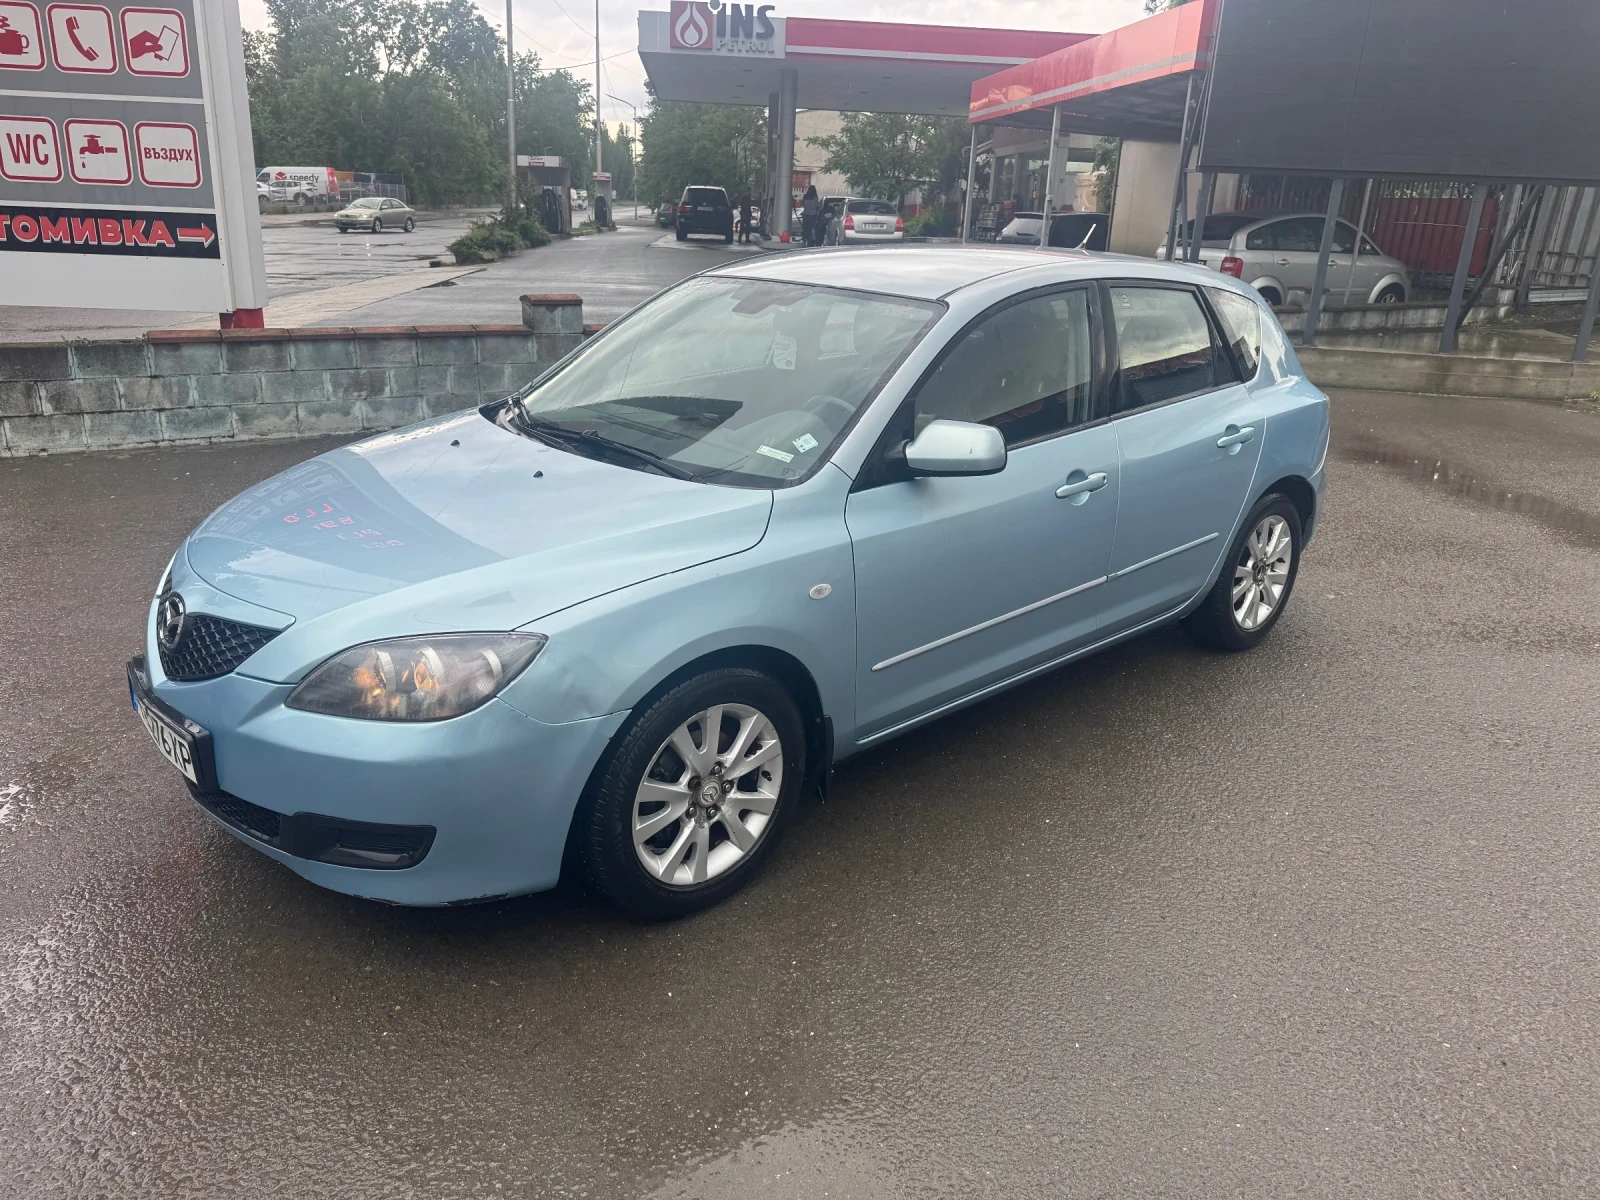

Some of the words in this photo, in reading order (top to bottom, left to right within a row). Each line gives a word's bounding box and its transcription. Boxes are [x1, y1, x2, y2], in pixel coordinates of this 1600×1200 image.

[715, 39, 775, 54] PETROL
[6, 132, 49, 166] WC
[144, 146, 194, 163] ВЪЗДУХ
[289, 173, 319, 183] speedy
